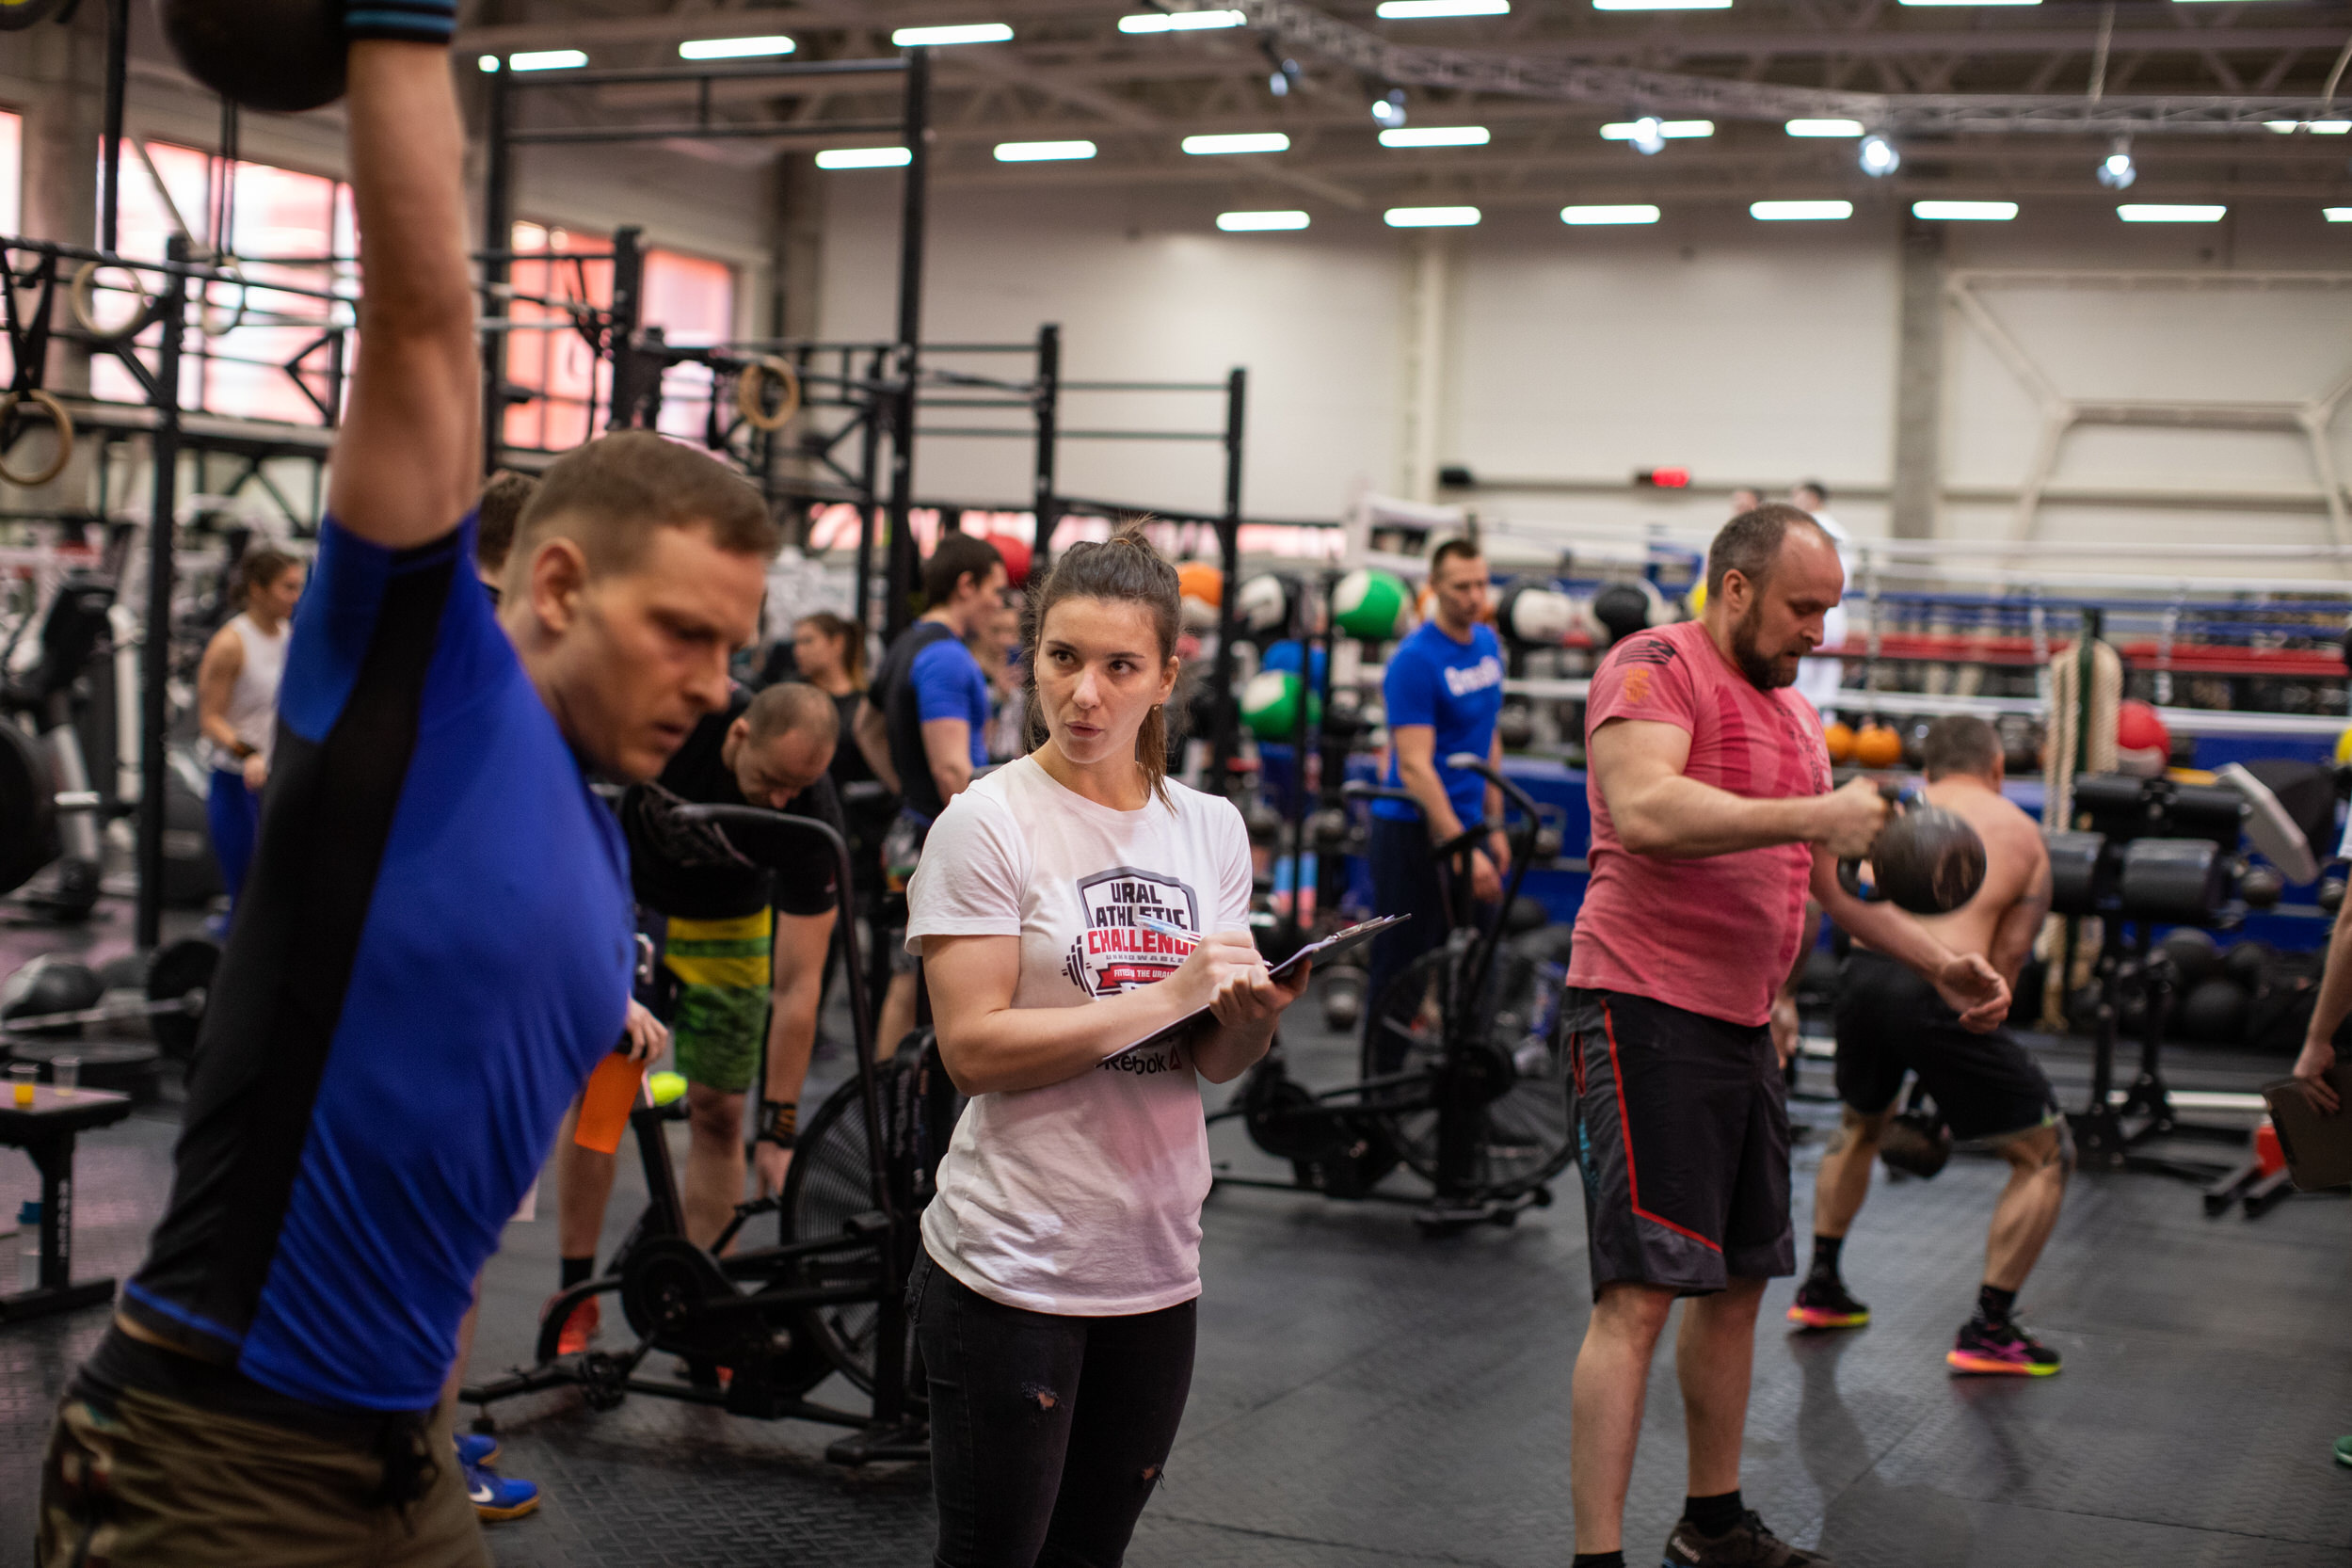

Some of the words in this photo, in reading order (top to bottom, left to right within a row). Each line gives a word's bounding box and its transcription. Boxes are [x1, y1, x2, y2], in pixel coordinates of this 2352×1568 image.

[1111, 882, 1162, 904] URAL
[1096, 904, 1188, 930] ATHLETIC
[1136, 969, 1151, 978] THE
[1151, 970, 1176, 980] URAL
